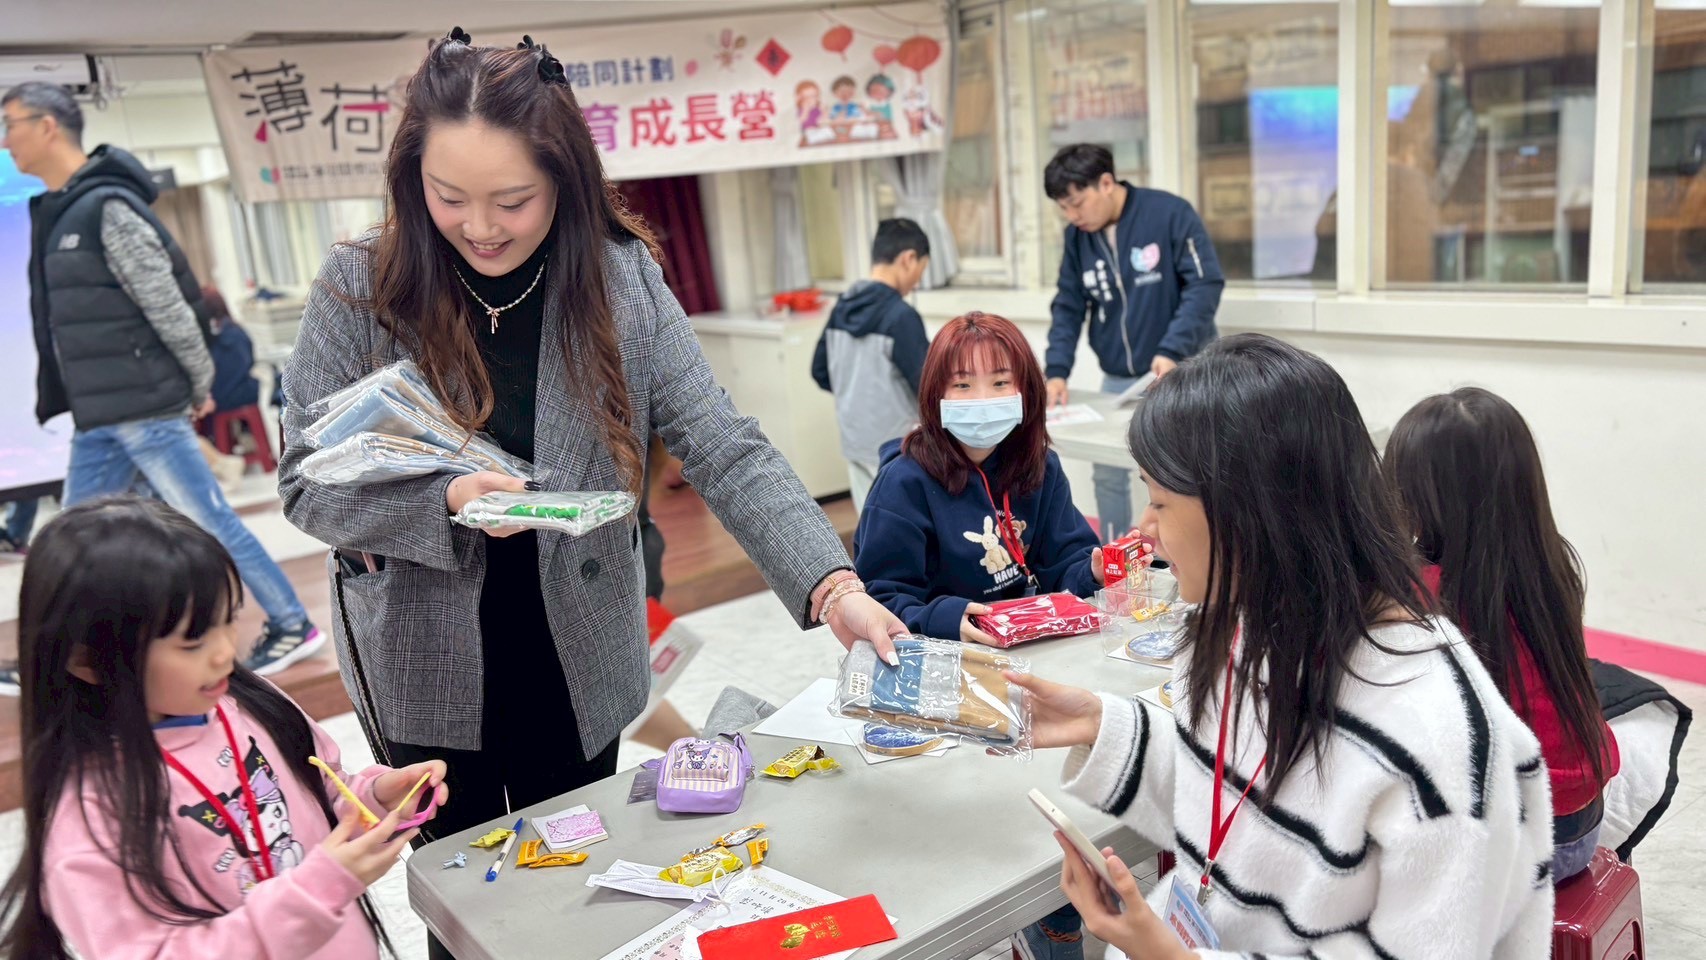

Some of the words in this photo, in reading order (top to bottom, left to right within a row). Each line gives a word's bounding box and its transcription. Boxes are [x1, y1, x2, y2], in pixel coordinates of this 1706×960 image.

[565, 56, 674, 88] 陪同計劃
[231, 60, 391, 155] 薄荷
[580, 90, 776, 152] 育成長營
[993, 563, 1020, 584] HAVE
